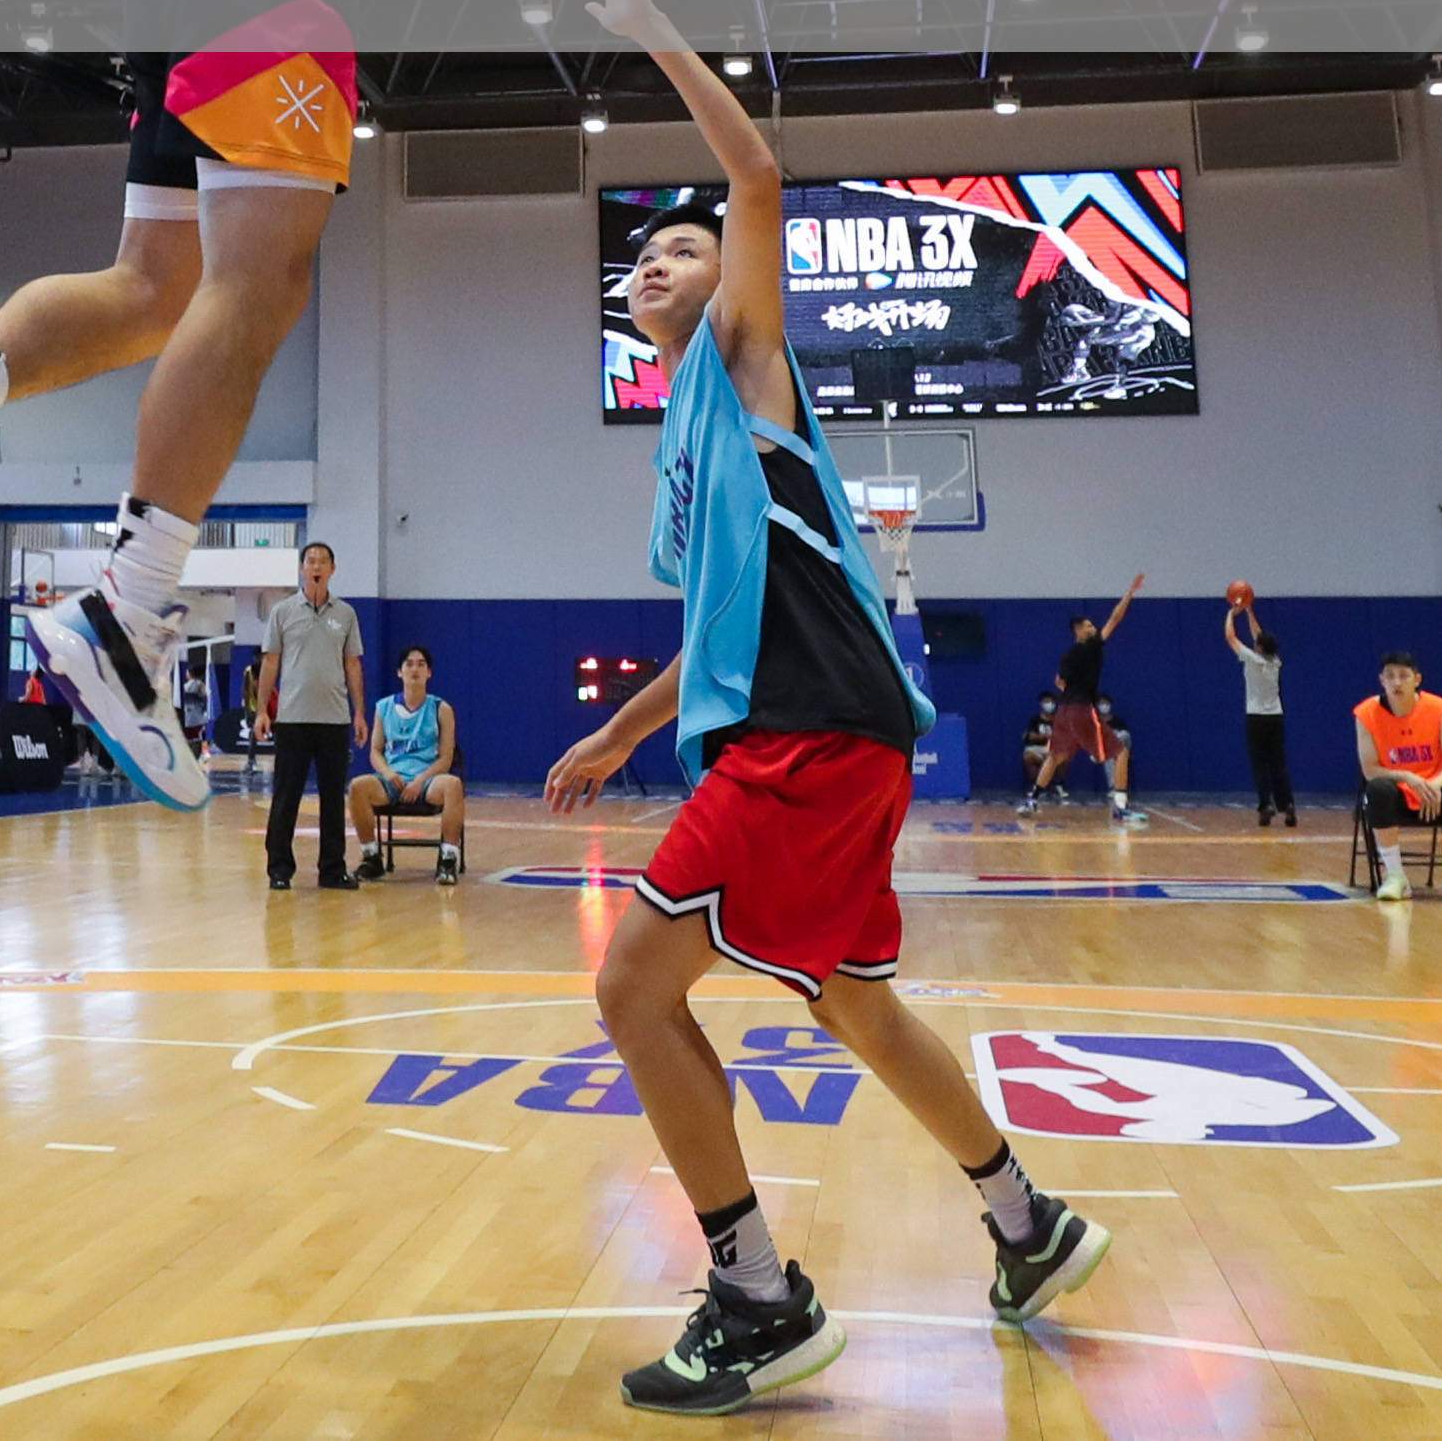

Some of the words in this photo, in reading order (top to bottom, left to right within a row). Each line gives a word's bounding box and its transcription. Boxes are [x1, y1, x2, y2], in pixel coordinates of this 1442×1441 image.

[825, 215, 915, 274] NBA
[919, 214, 979, 271] 3X
[364, 1053, 863, 1126] NBA
